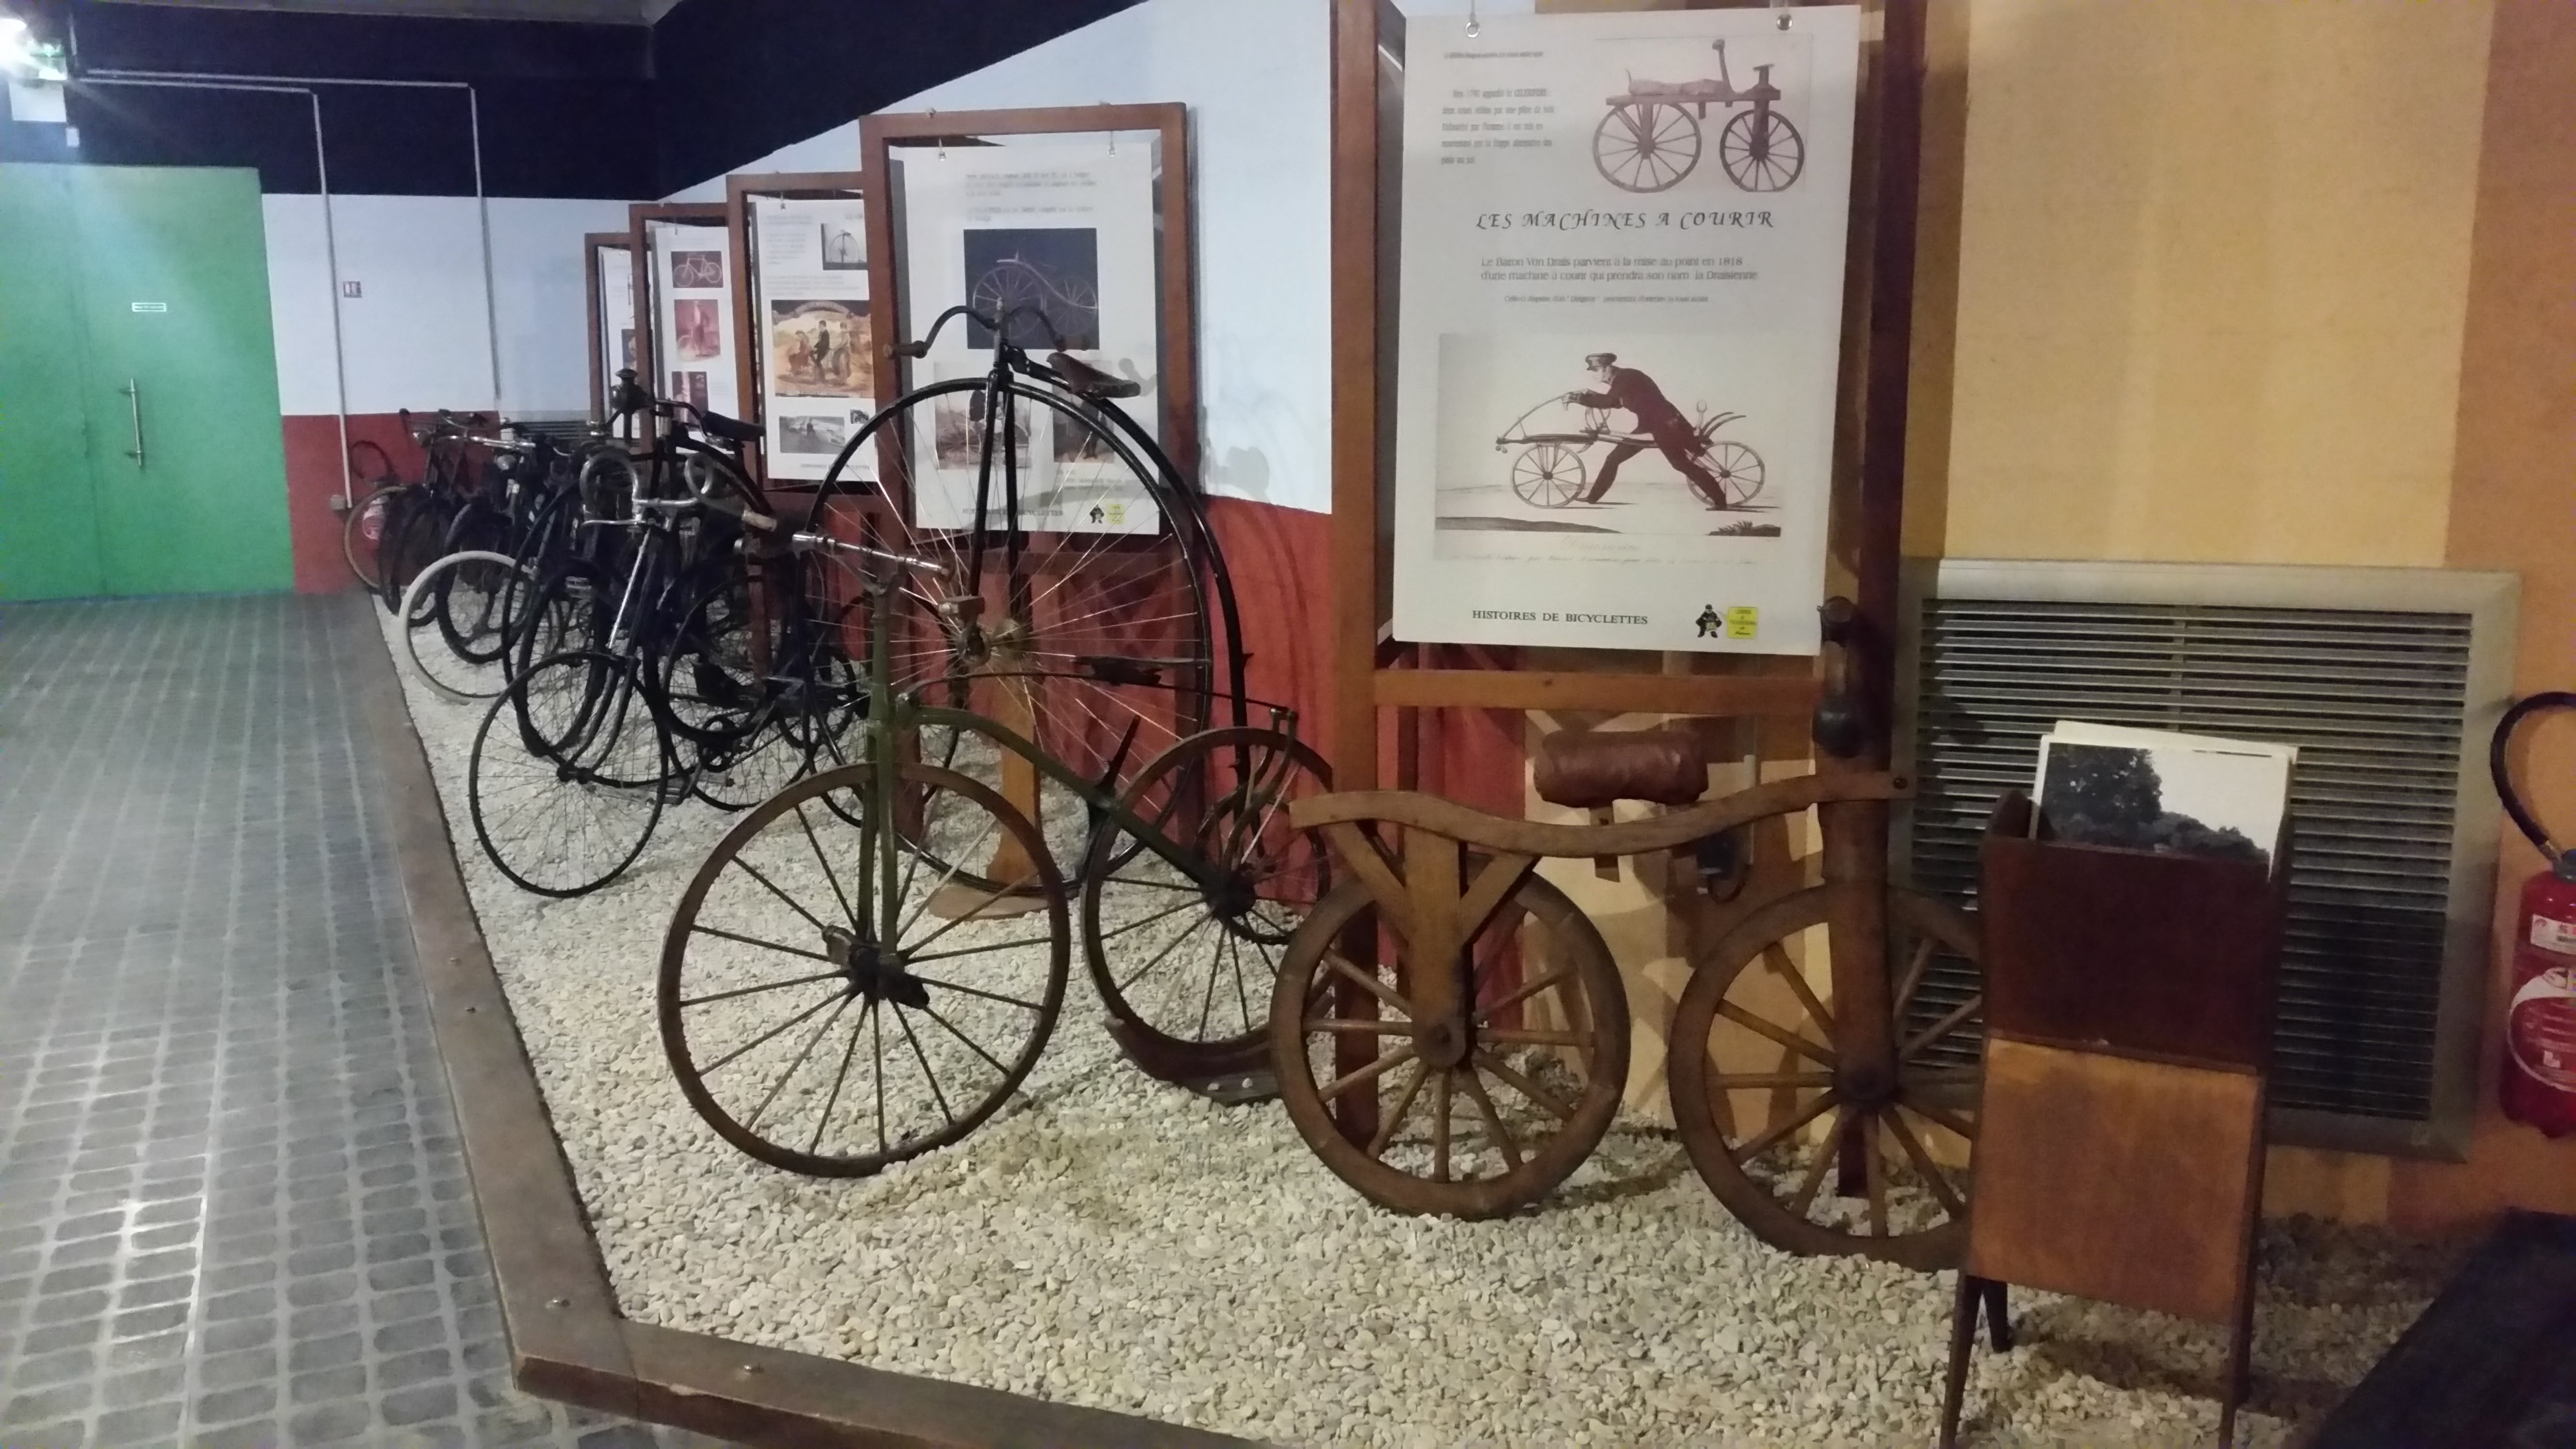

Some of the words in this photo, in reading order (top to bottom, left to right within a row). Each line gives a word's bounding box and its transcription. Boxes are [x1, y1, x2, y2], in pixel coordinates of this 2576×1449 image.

[1476, 214, 1512, 229] LES
[1521, 209, 1646, 230] MACHINES
[1655, 212, 1669, 226] A
[1680, 211, 1773, 230] COURIR
[1481, 258, 1493, 266] Le
[1496, 258, 1524, 266] Baron
[1527, 258, 1544, 266] Von
[1574, 258, 1611, 268] parvient
[1623, 258, 1631, 266] la
[1634, 258, 1657, 266] mise
[1674, 258, 1699, 268] point
[1718, 257, 1743, 266] 1818
[1481, 271, 1505, 280] d'une
[1509, 271, 1549, 280] machine
[1560, 272, 1587, 280] courir
[1590, 272, 1604, 282] qui
[1607, 271, 1643, 282] prendra
[1472, 610, 1536, 621] HISTOIRES
[1542, 612, 1560, 622] DE
[1565, 613, 1648, 625] BICYCLETTES
